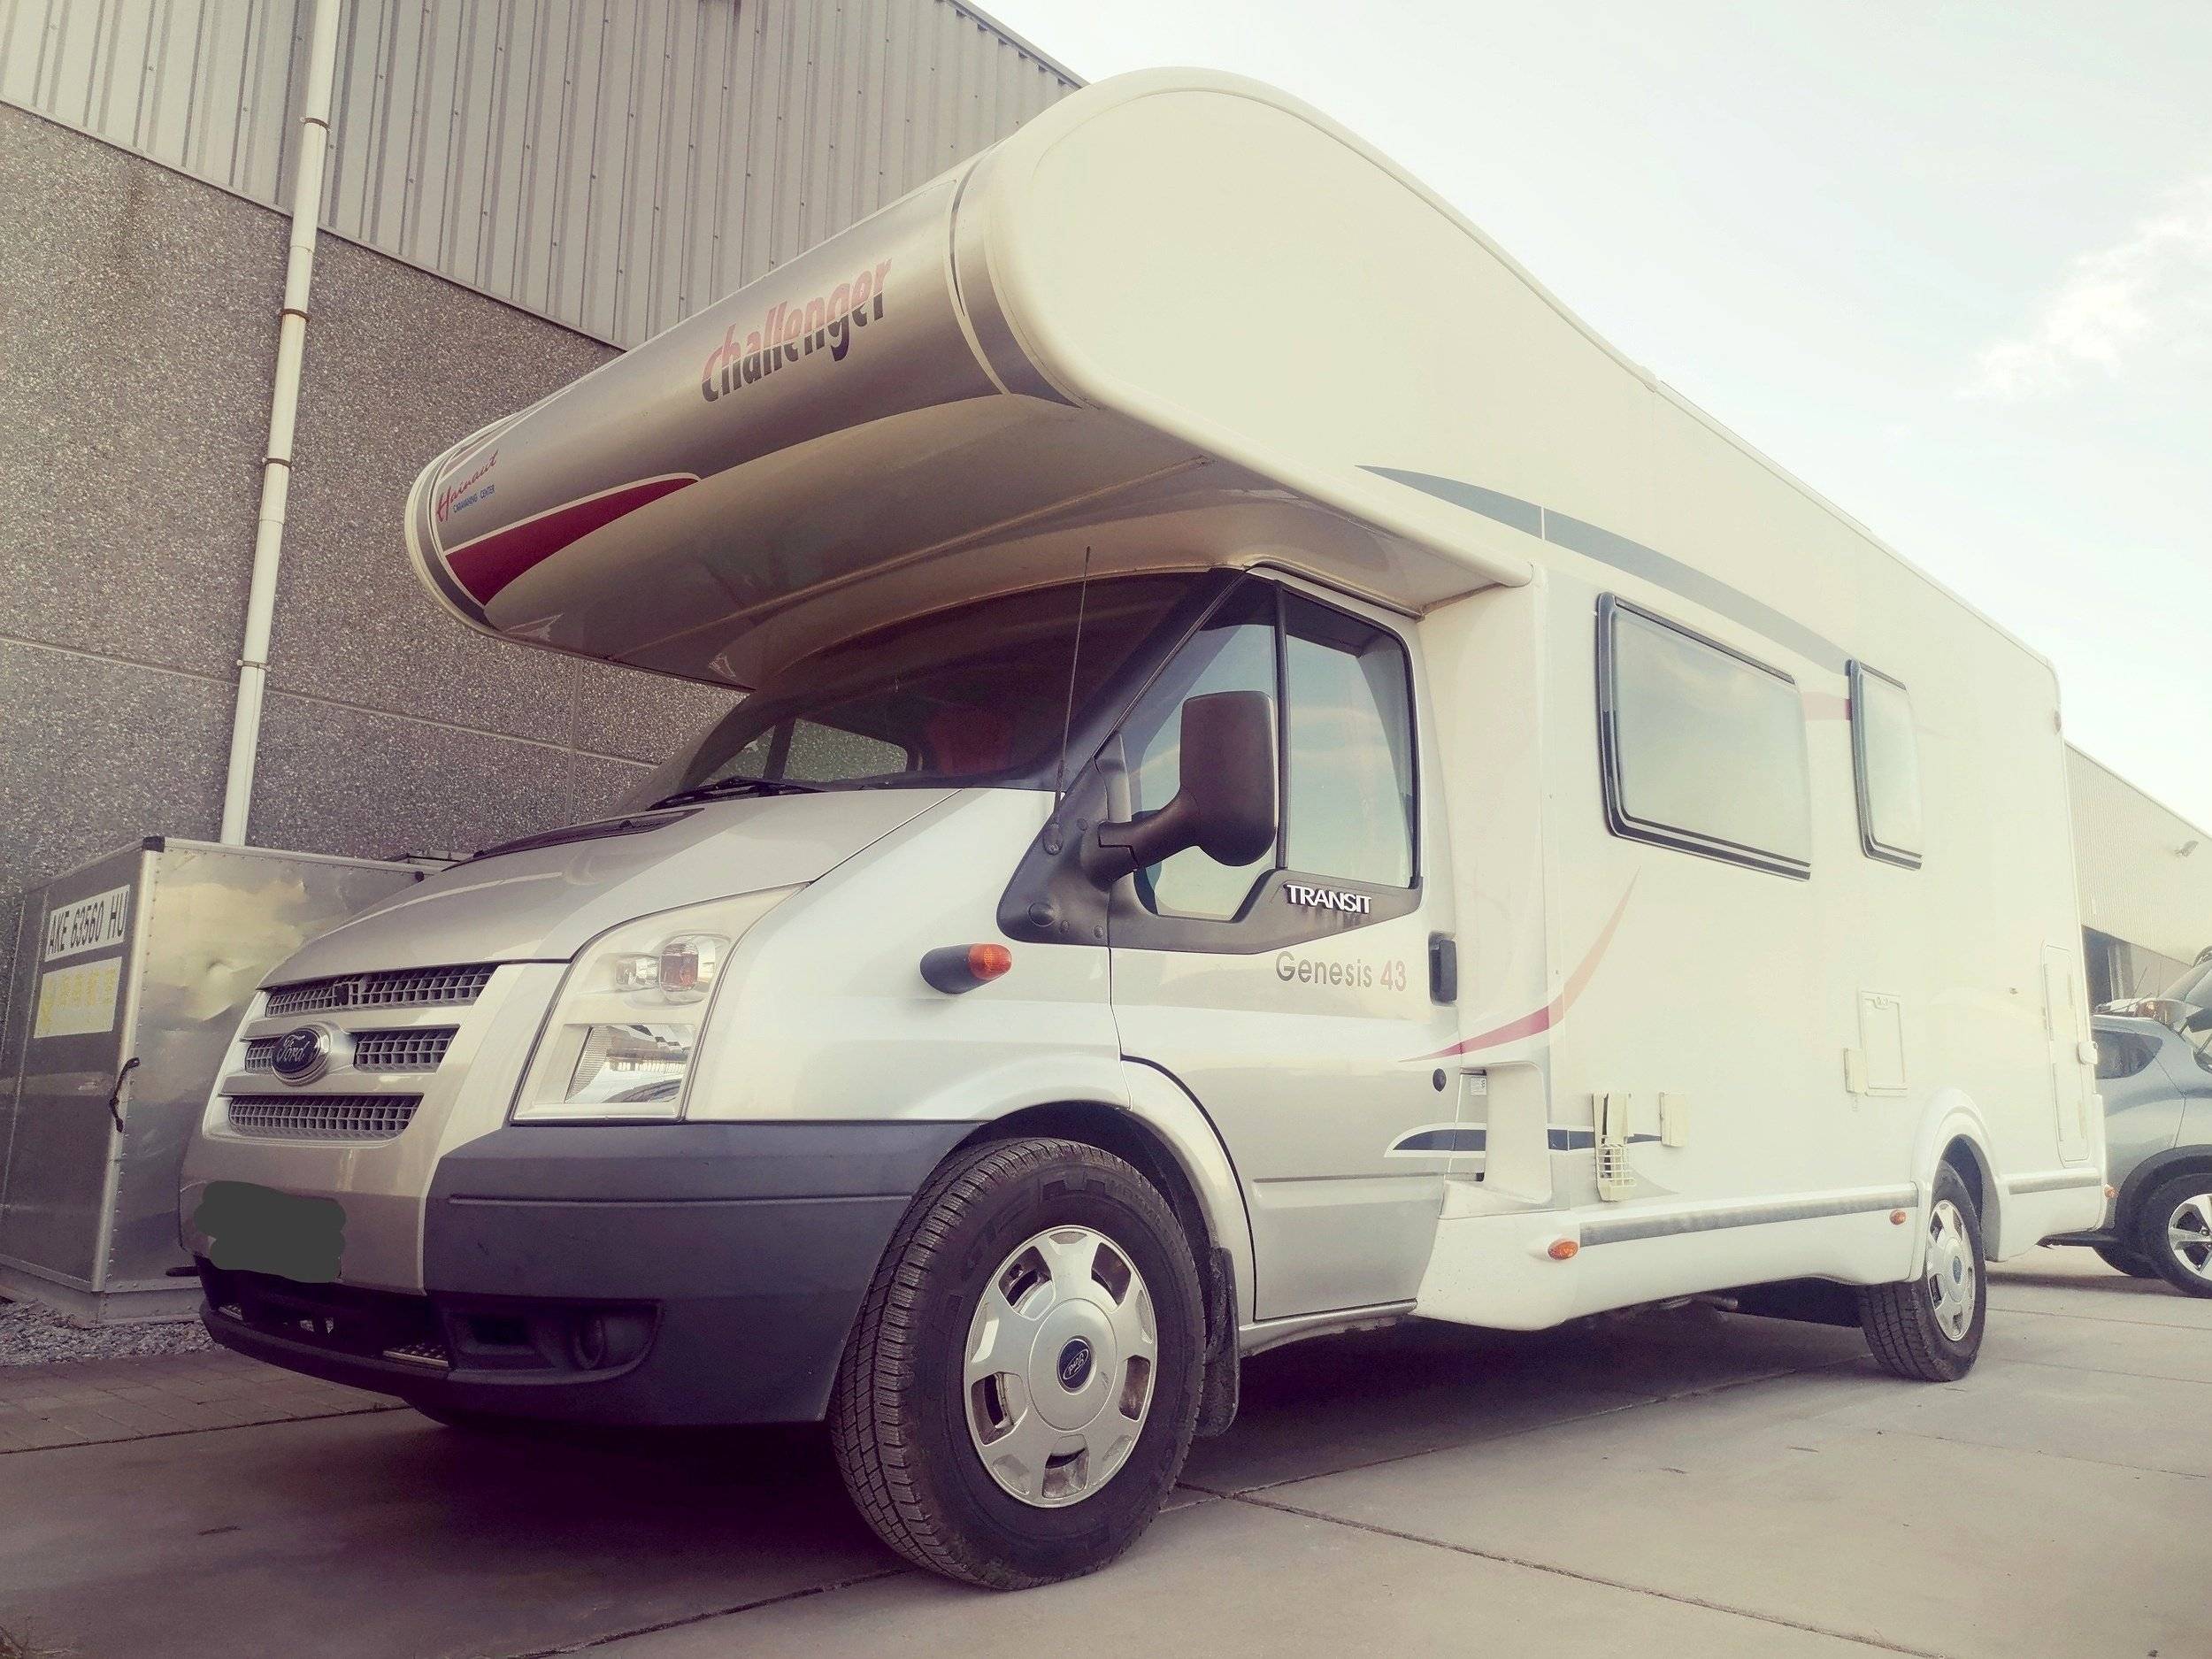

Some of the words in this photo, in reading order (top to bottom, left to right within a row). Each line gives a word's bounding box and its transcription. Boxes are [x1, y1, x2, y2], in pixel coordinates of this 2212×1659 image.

[1286, 884, 1371, 914] TRANSIT
[47, 910, 69, 955] AKE
[107, 891, 128, 940] HU
[1276, 950, 1372, 987] Genesis
[1379, 960, 1407, 992] 43
[276, 1034, 311, 1063] Ford
